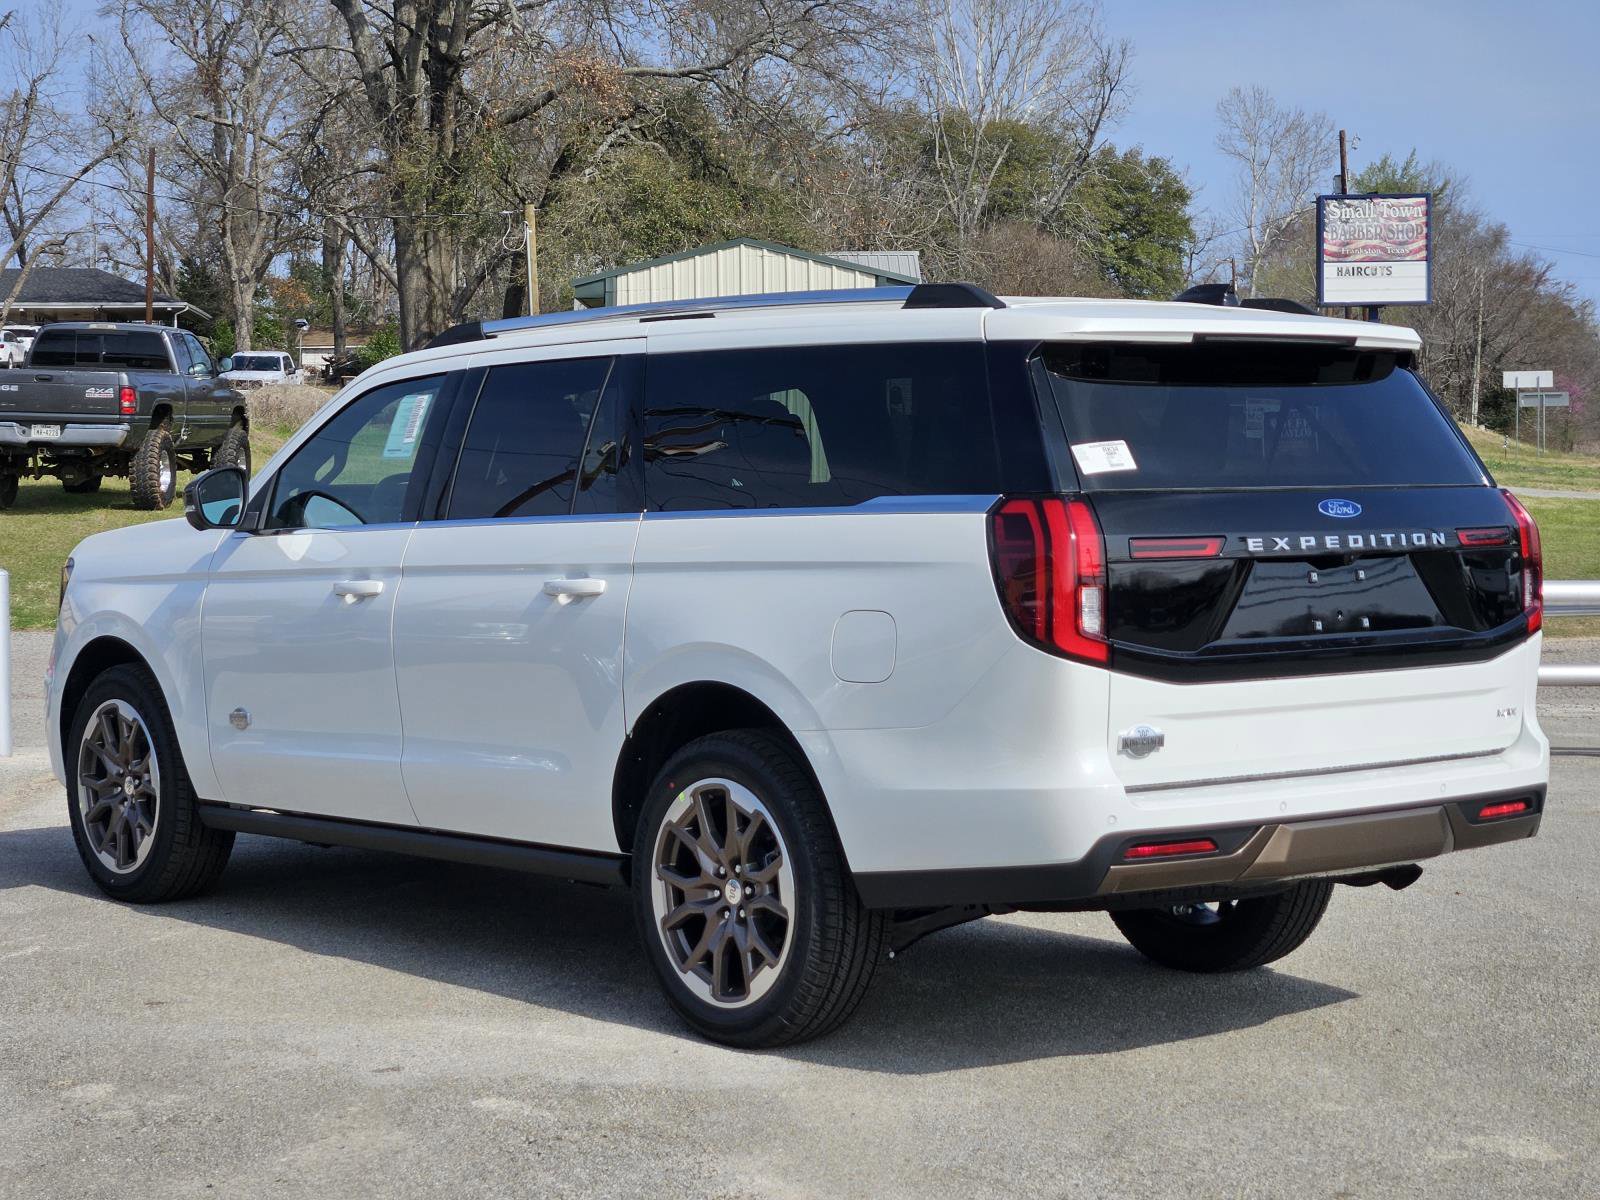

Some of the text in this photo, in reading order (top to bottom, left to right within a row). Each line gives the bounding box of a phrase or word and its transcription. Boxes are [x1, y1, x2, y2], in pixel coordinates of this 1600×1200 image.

[1328, 200, 1423, 219] Small Town
[1329, 222, 1424, 240] BARBER SHOP
[1386, 246, 1410, 254] Texas
[1336, 266, 1393, 277] HAIRCUTS
[1328, 500, 1355, 515] Ford
[1247, 532, 1446, 552] EXPEDITION
